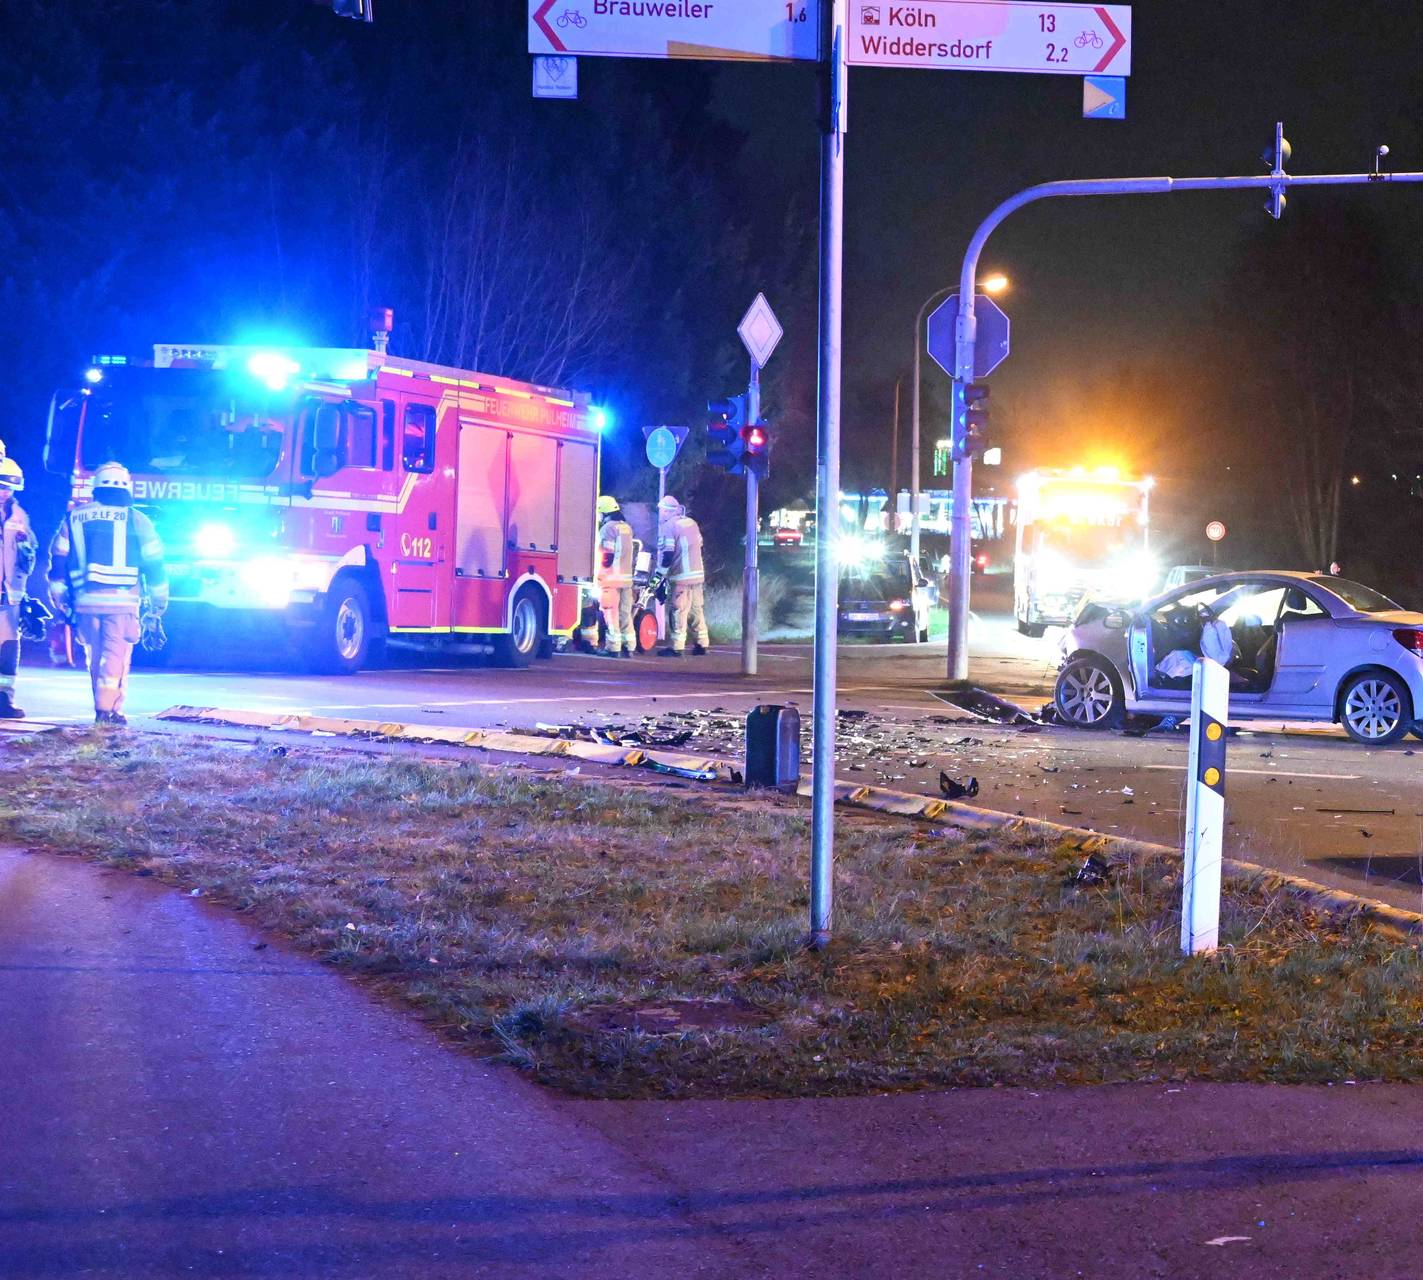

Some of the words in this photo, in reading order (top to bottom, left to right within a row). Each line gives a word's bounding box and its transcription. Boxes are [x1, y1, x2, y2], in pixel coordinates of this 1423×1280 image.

[593, 0, 714, 19] Brauweiler
[785, 2, 807, 22] 1,6
[888, 7, 936, 28] Köln
[1038, 13, 1056, 33] 13
[860, 35, 993, 60] Widdersdorf
[1045, 43, 1069, 63] 2,2
[411, 537, 432, 558] 112
